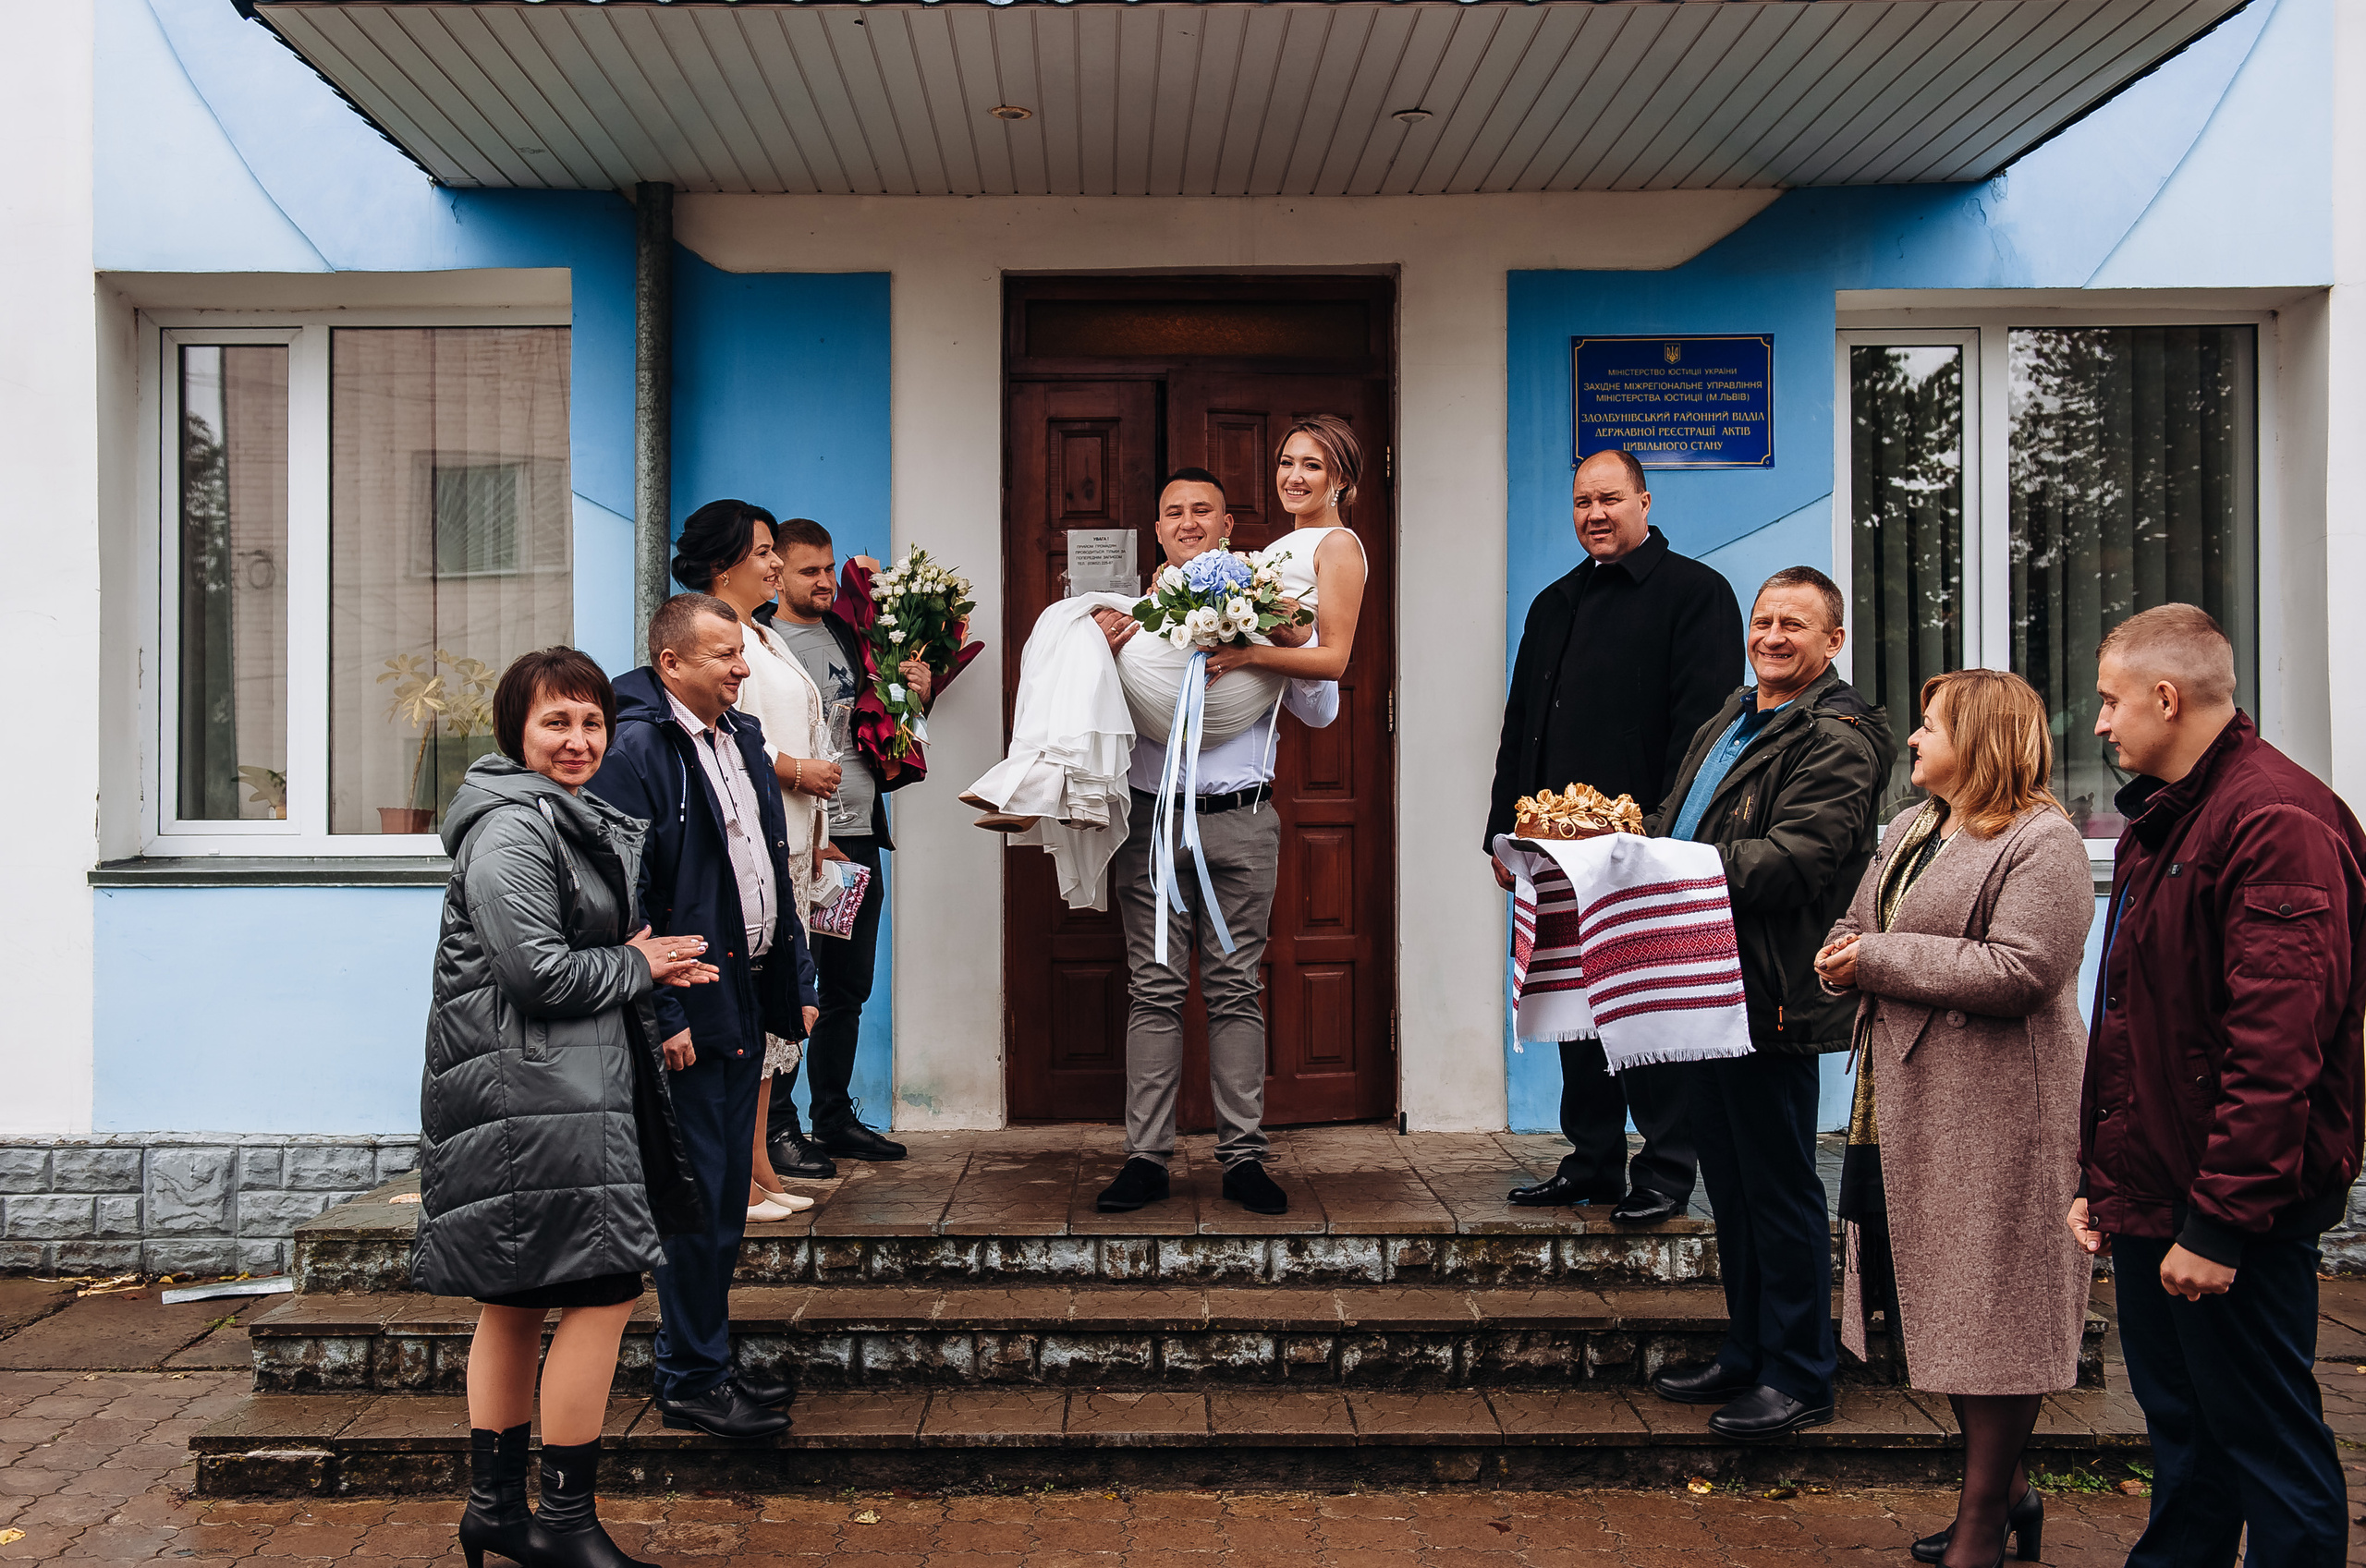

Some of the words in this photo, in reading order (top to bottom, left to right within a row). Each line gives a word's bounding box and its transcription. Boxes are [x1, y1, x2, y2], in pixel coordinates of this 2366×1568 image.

[1668, 368, 1701, 376] ЮСТИЦІЇ
[1583, 383, 1620, 391] ЗАХІДНЕ
[1624, 382, 1703, 390] МІЖРЕГІОНАЛЬНЕ
[1706, 381, 1762, 390] УПРАВЛІННЯ
[1596, 394, 1661, 402] МІНІСТЕРСТВА
[1664, 393, 1702, 403] ЮСТИЦІЇ
[1581, 411, 1671, 422] ЗДОЛБУНІВСЬКИЙ
[1674, 411, 1729, 421] РАЙОННИЙ
[1732, 412, 1765, 421] ВІДДІЛ
[1595, 426, 1655, 437] ДЕРЖАВНОЇ
[1658, 425, 1715, 436] РЕЄСТРАЦІЇ
[1721, 427, 1751, 436] АКТІВ
[1623, 442, 1689, 451] ЦИВІЛЬНОГО
[1690, 441, 1724, 450] СТАНУ
